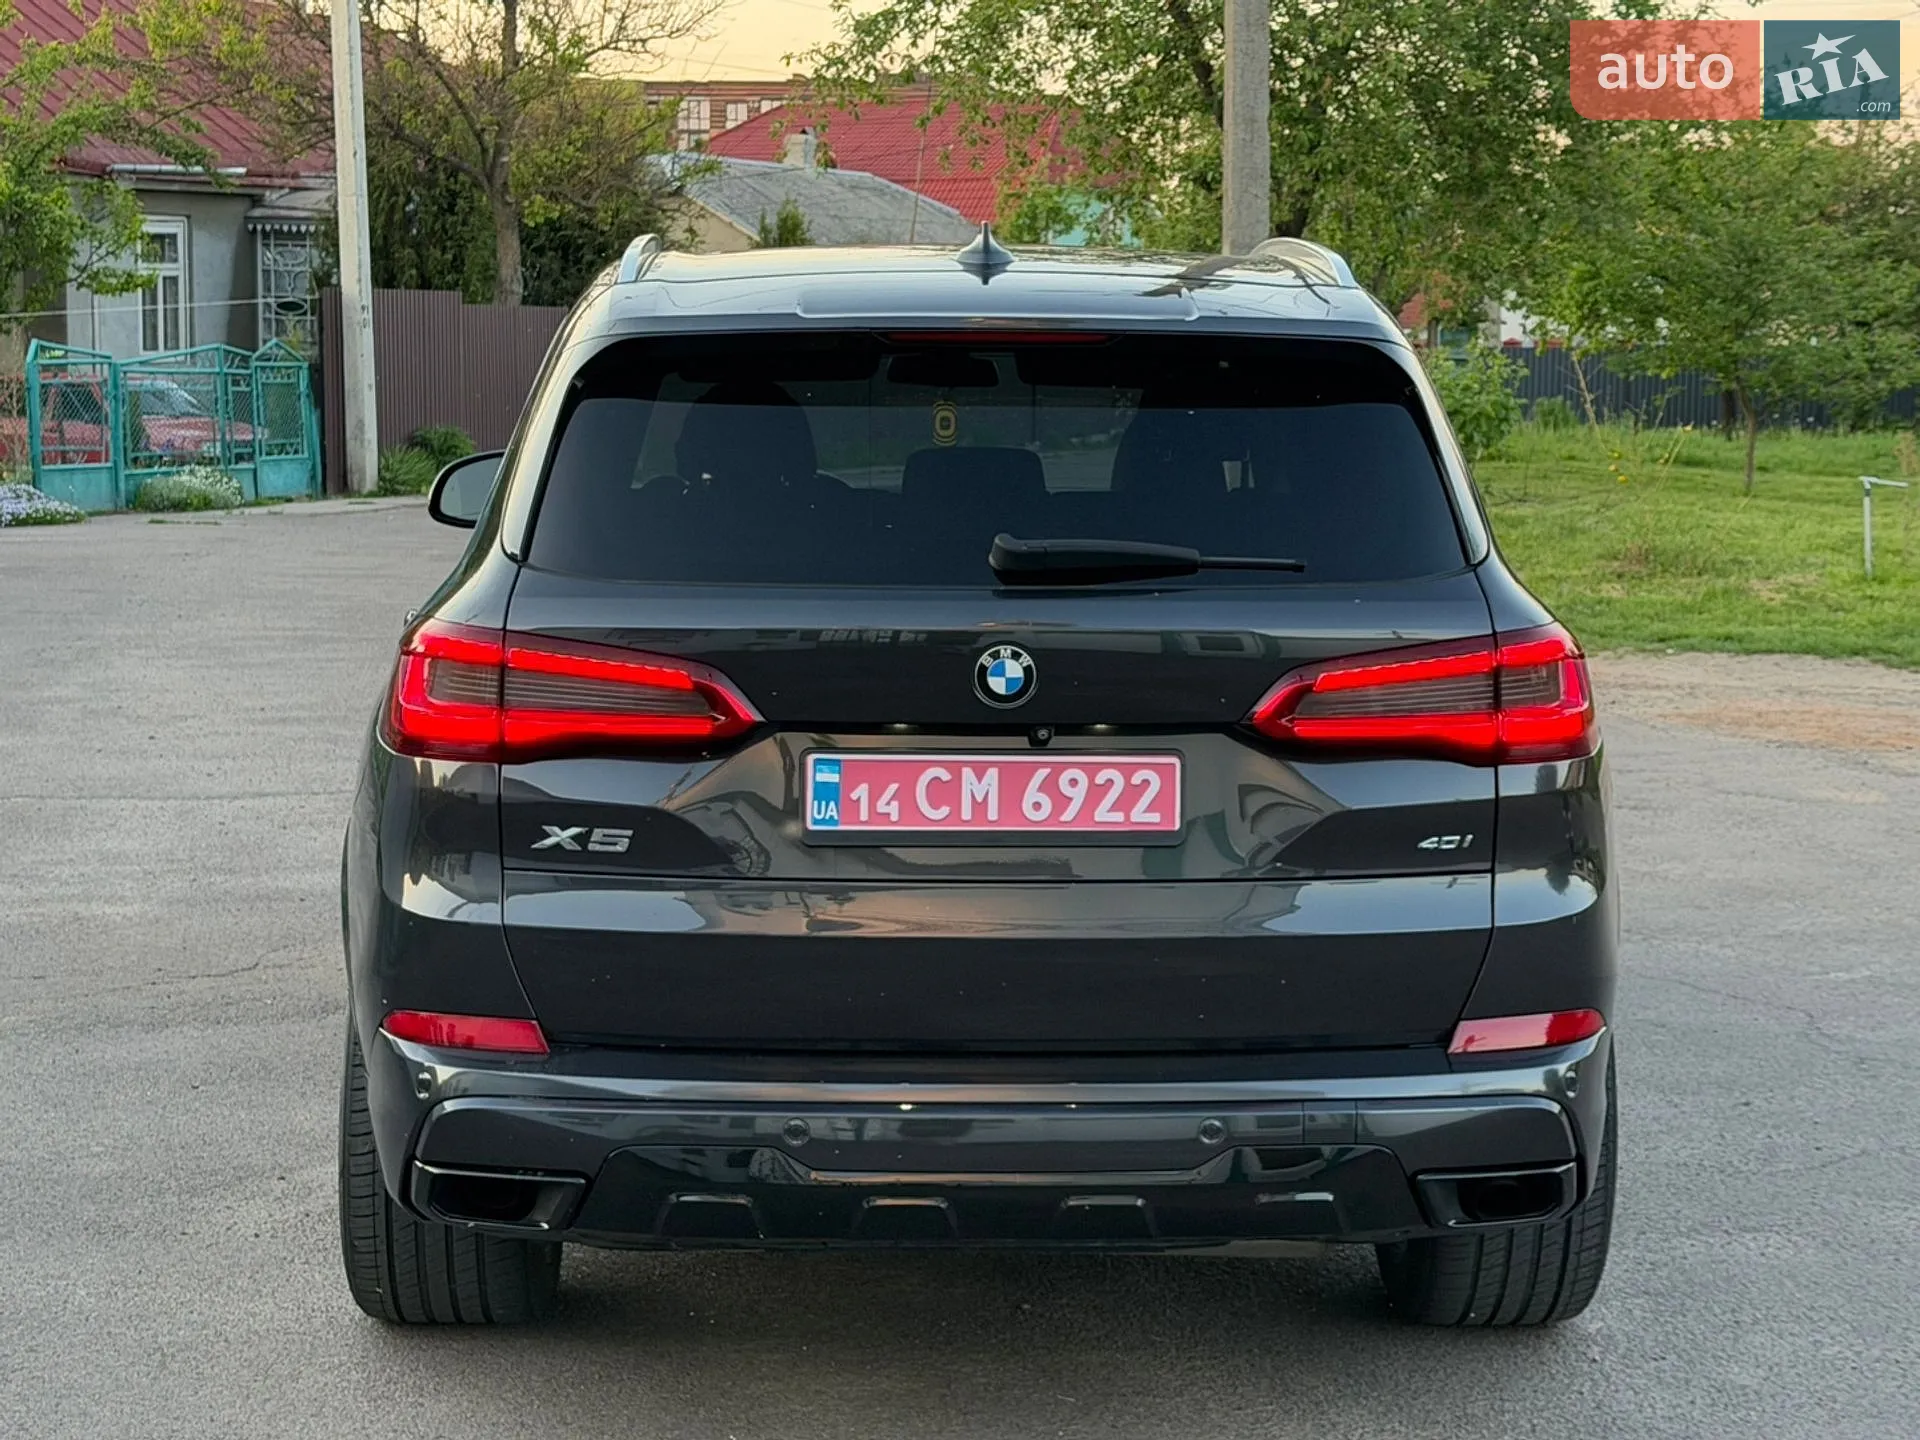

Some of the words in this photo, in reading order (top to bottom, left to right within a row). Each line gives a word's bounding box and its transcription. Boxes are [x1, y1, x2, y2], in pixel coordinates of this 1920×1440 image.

[980, 648, 1032, 668] BMW
[849, 783, 900, 823] 14
[915, 766, 999, 822] CM
[1021, 767, 1162, 823] 6922
[813, 800, 839, 821] UA
[530, 825, 634, 853] X5
